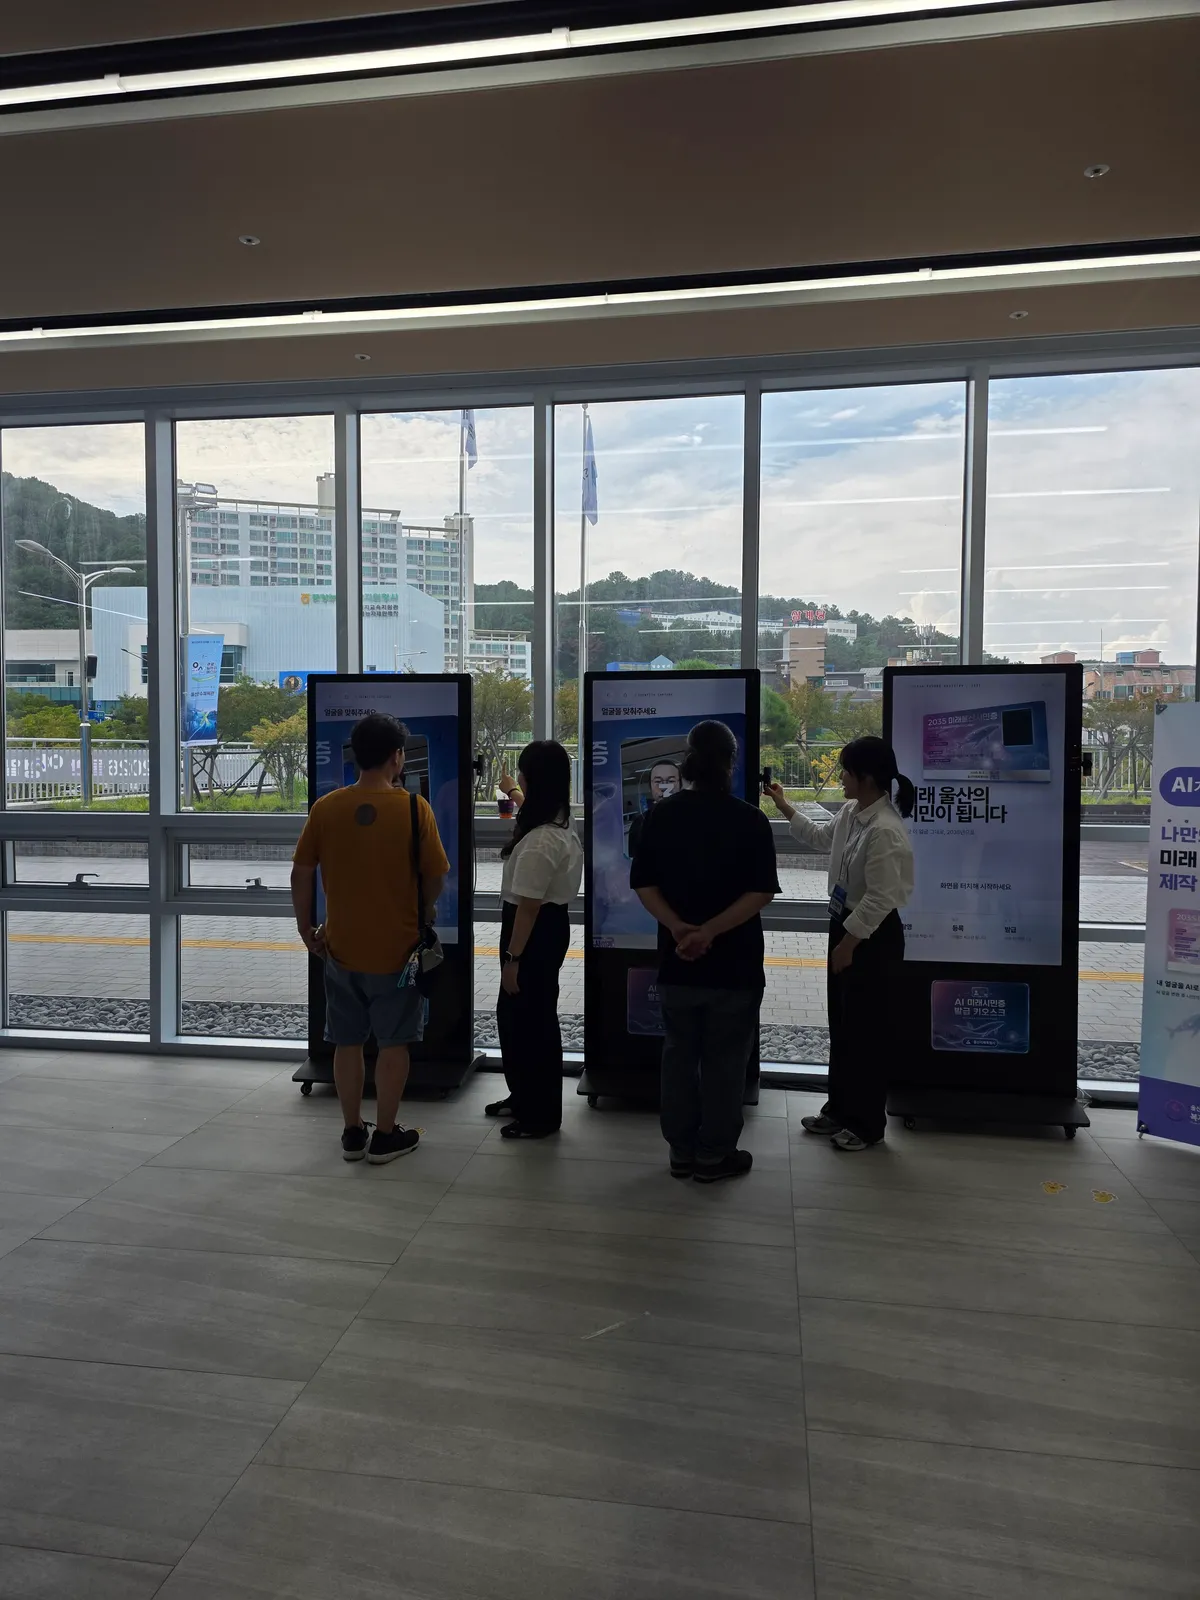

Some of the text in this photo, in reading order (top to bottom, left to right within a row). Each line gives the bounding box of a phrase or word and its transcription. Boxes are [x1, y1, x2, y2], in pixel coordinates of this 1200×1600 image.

[324, 708, 343, 717] 얼굴을
[601, 707, 657, 716] 얼굴을 맞춰주세요
[927, 717, 947, 726] 2035
[938, 786, 990, 805] 울산의
[956, 805, 1008, 824] 됩니다
[1161, 826, 1200, 844] 나만
[1160, 849, 1198, 868] 미래
[940, 882, 1012, 891] 화면을 터치해 시작하세요
[1159, 873, 1198, 892] 제작
[1164, 980, 1184, 990] 얼굴을
[954, 998, 1006, 1008] AI 미래시민증
[954, 1007, 1006, 1017] 발급 키오스크
